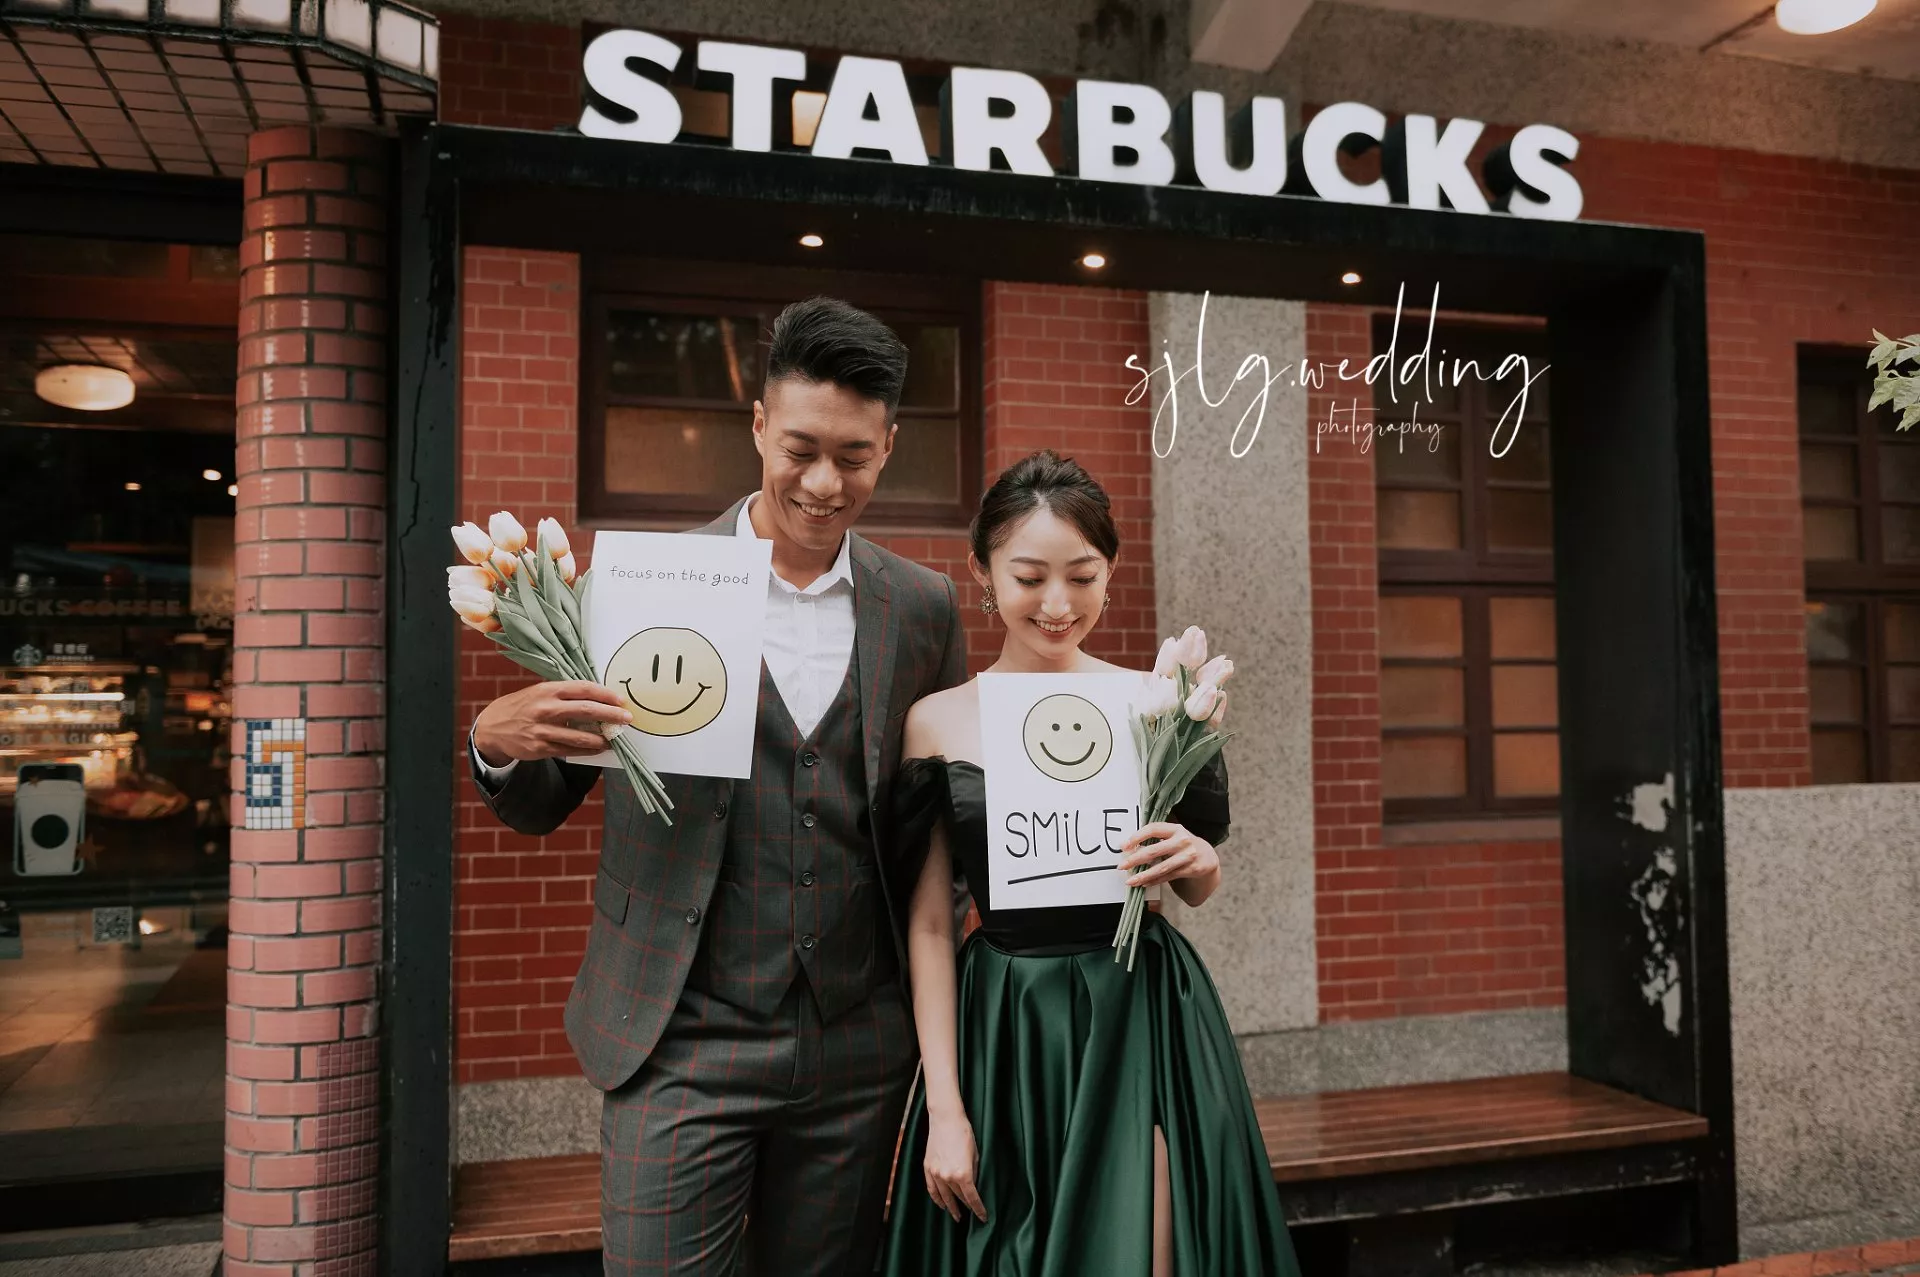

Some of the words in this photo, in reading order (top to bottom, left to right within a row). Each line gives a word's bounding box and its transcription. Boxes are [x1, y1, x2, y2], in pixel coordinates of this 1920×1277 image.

[577, 28, 1585, 223] STARBUCKS
[609, 565, 653, 580] focus
[657, 570, 676, 581] on
[681, 568, 707, 583] the
[711, 572, 750, 587] good
[77, 599, 182, 617] COFFEE
